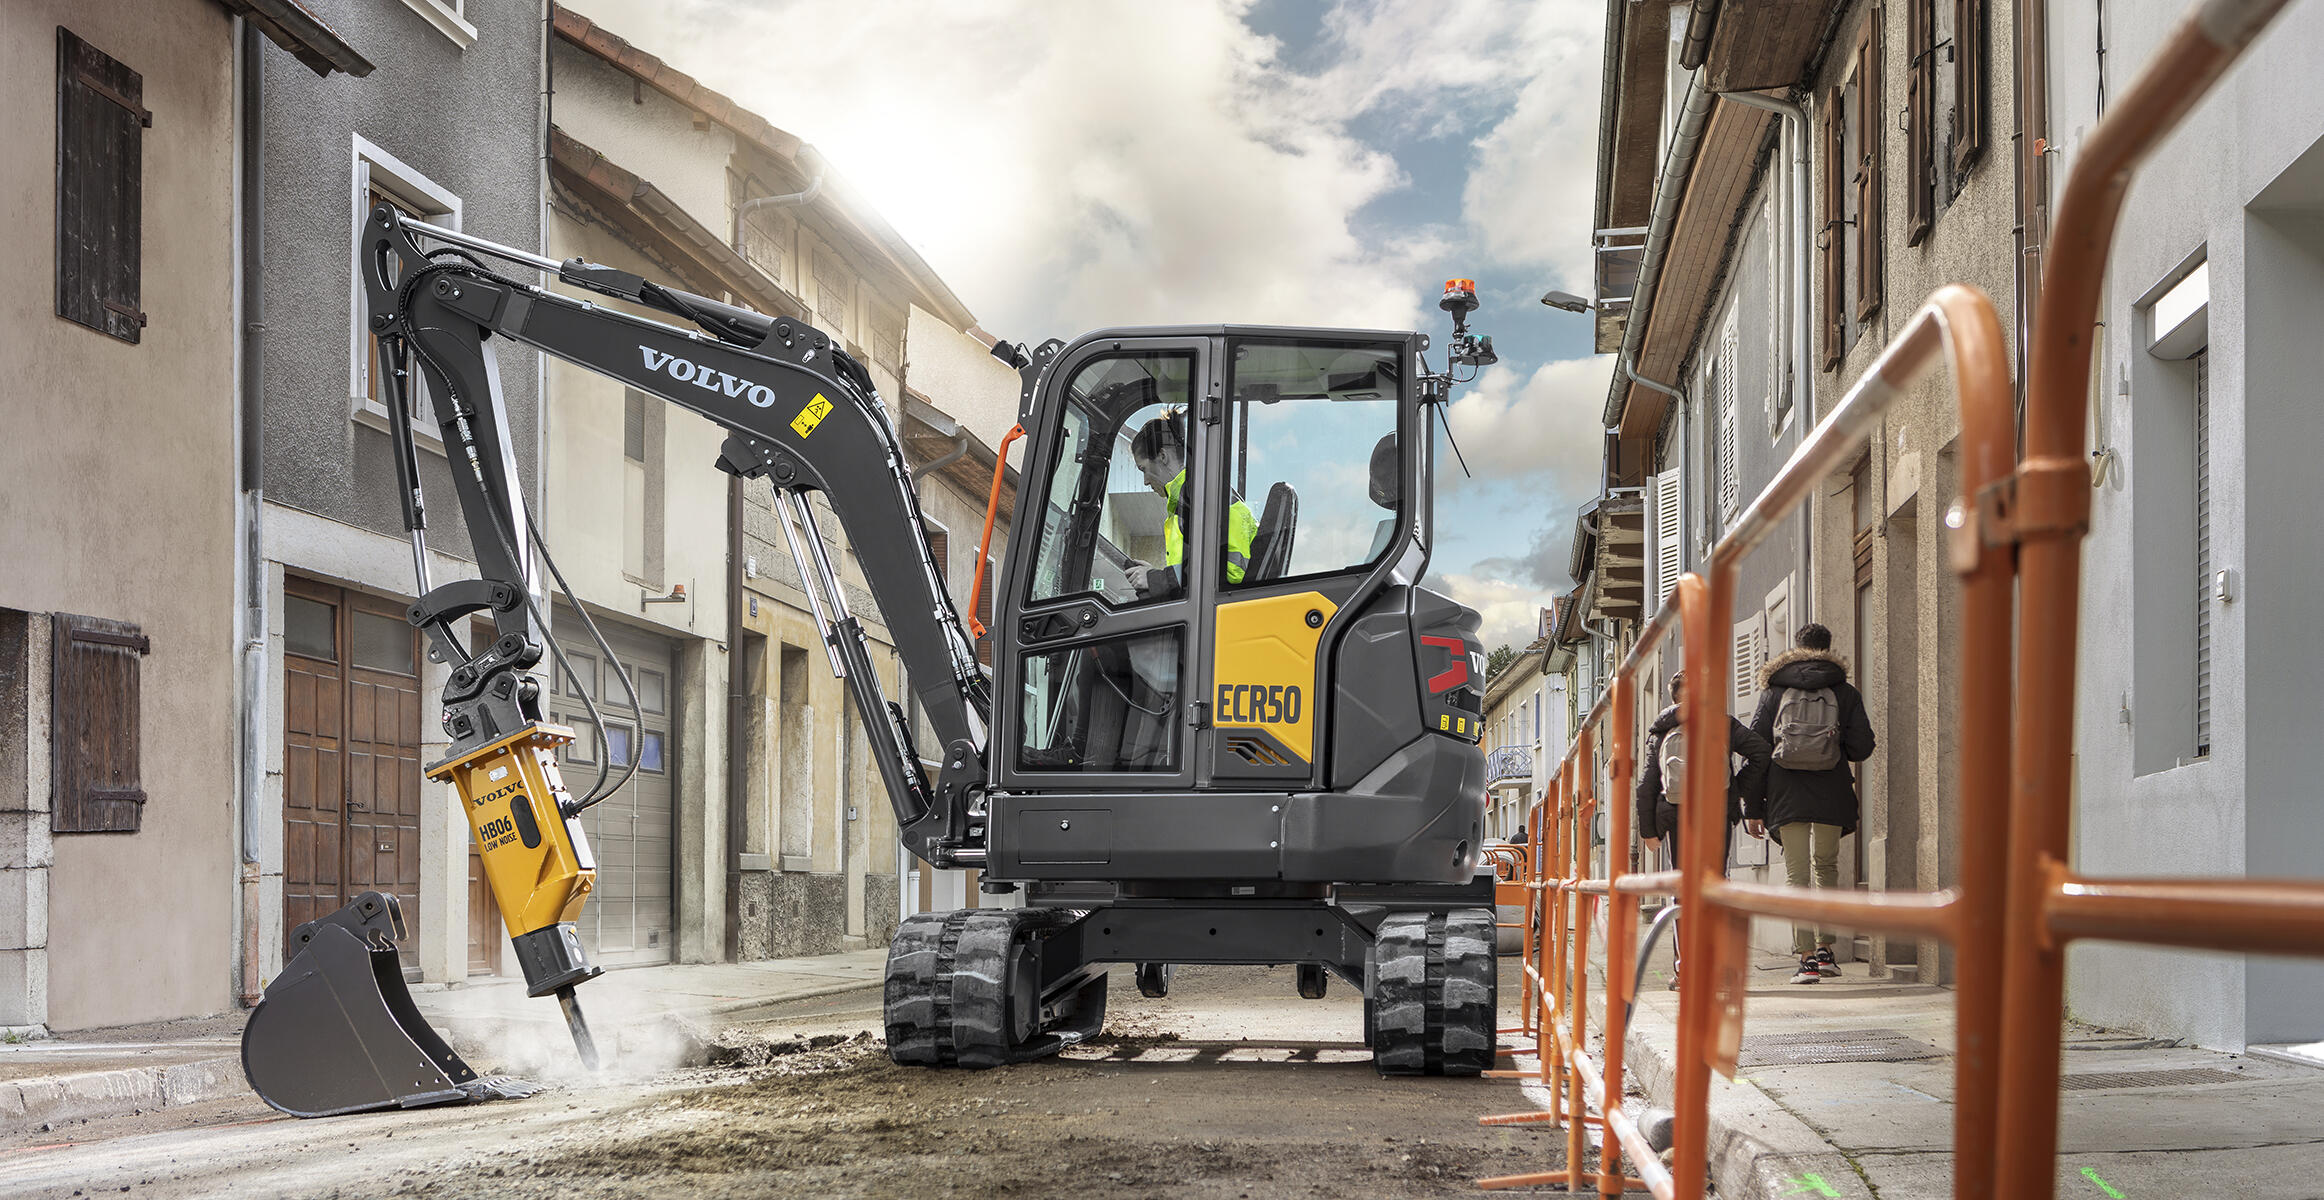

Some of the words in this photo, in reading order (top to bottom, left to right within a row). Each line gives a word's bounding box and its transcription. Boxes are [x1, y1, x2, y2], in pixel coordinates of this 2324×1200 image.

[638, 345, 776, 408] VOLVO
[1217, 684, 1302, 724] ECR50
[479, 815, 513, 842] HB06
[484, 840, 498, 853] LOW
[499, 832, 518, 847] NOISE
